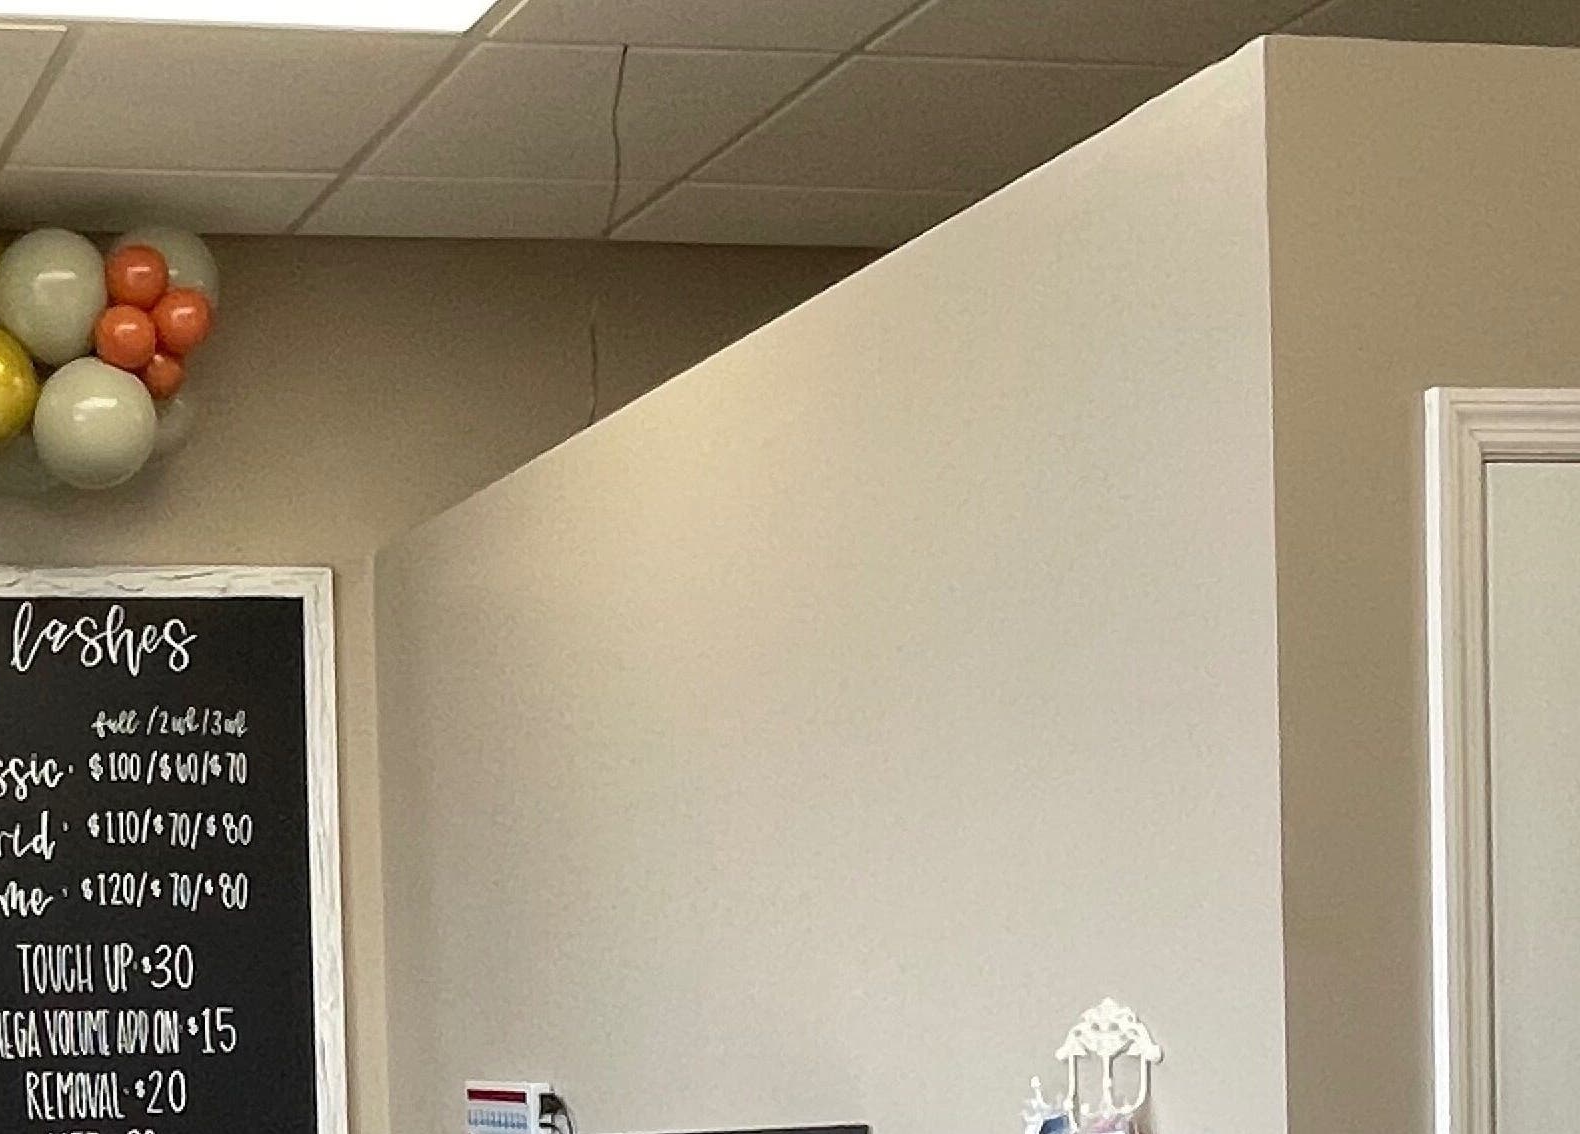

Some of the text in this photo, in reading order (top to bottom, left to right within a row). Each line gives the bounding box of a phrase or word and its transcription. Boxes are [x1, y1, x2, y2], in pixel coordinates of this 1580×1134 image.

[10, 600, 198, 678] lashes
[15, 943, 94, 995] TOUCH
[103, 942, 134, 994] UP
[45, 1008, 112, 1057] VOLUME
[153, 1008, 180, 1054] ON
[187, 1006, 237, 1054] $15
[25, 1069, 186, 1121] REMOVAL $20
